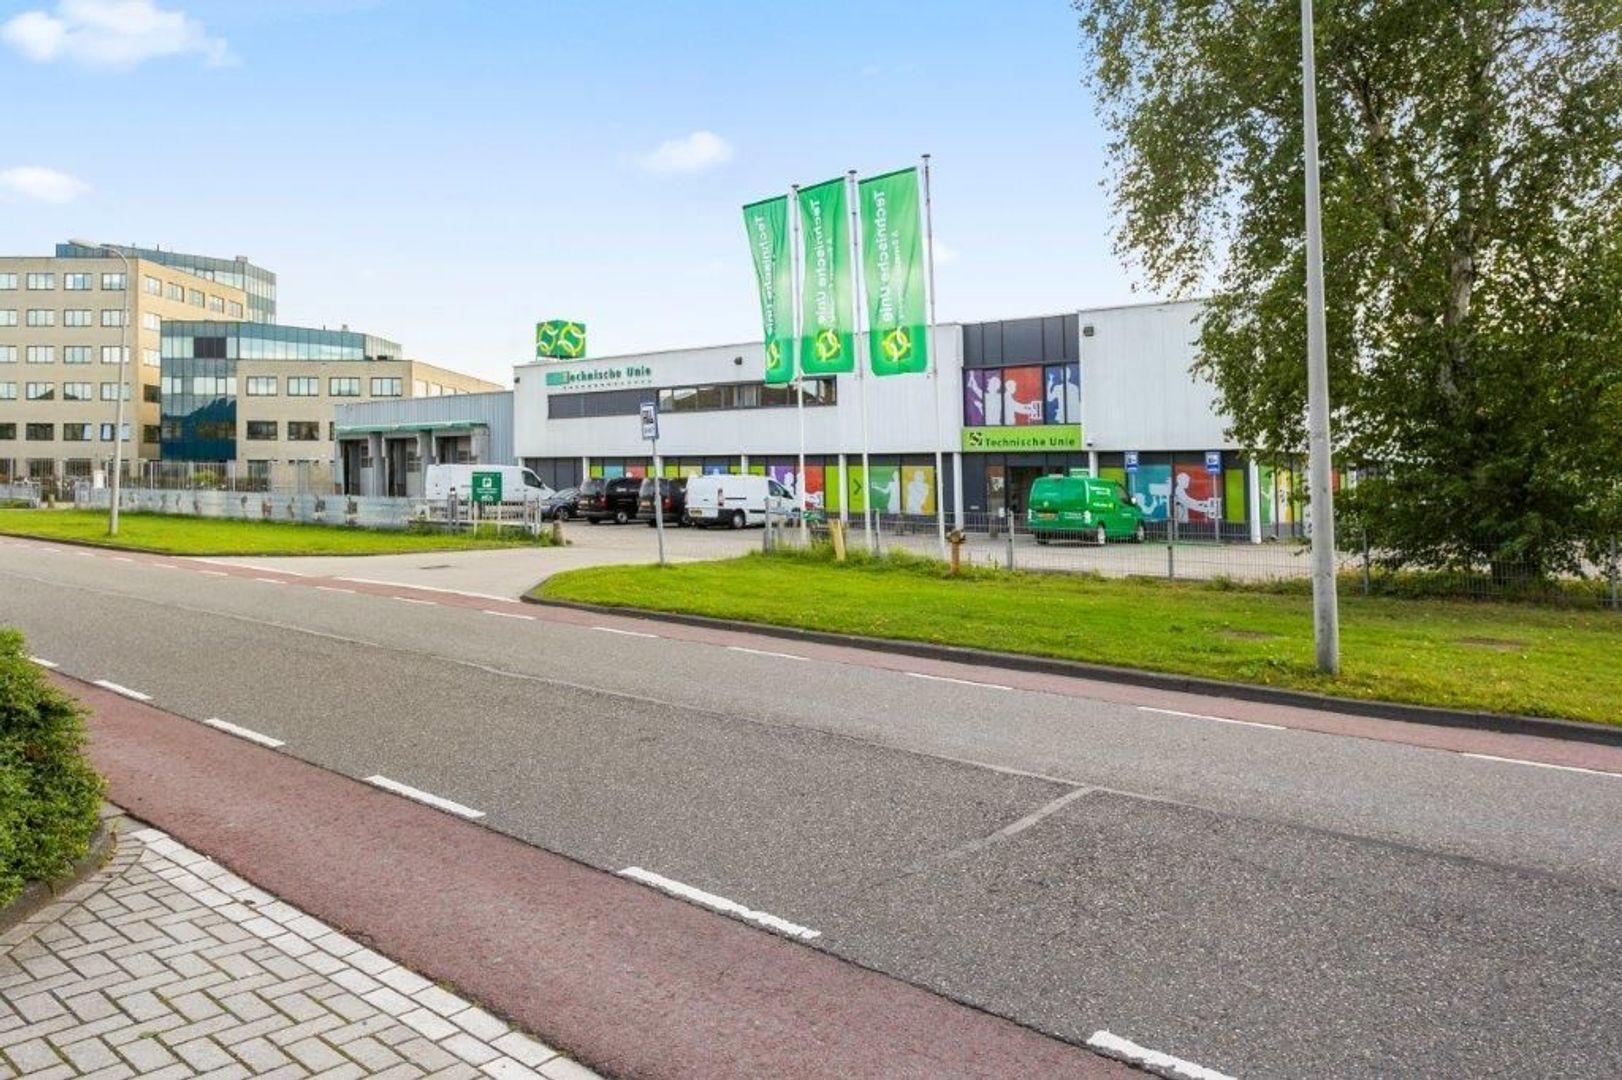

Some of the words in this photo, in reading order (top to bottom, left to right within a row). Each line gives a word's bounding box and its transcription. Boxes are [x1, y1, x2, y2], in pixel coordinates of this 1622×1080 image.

[626, 364, 652, 378] Unie
[985, 437, 1046, 448] Technische
[1049, 436, 1076, 447] Unie
